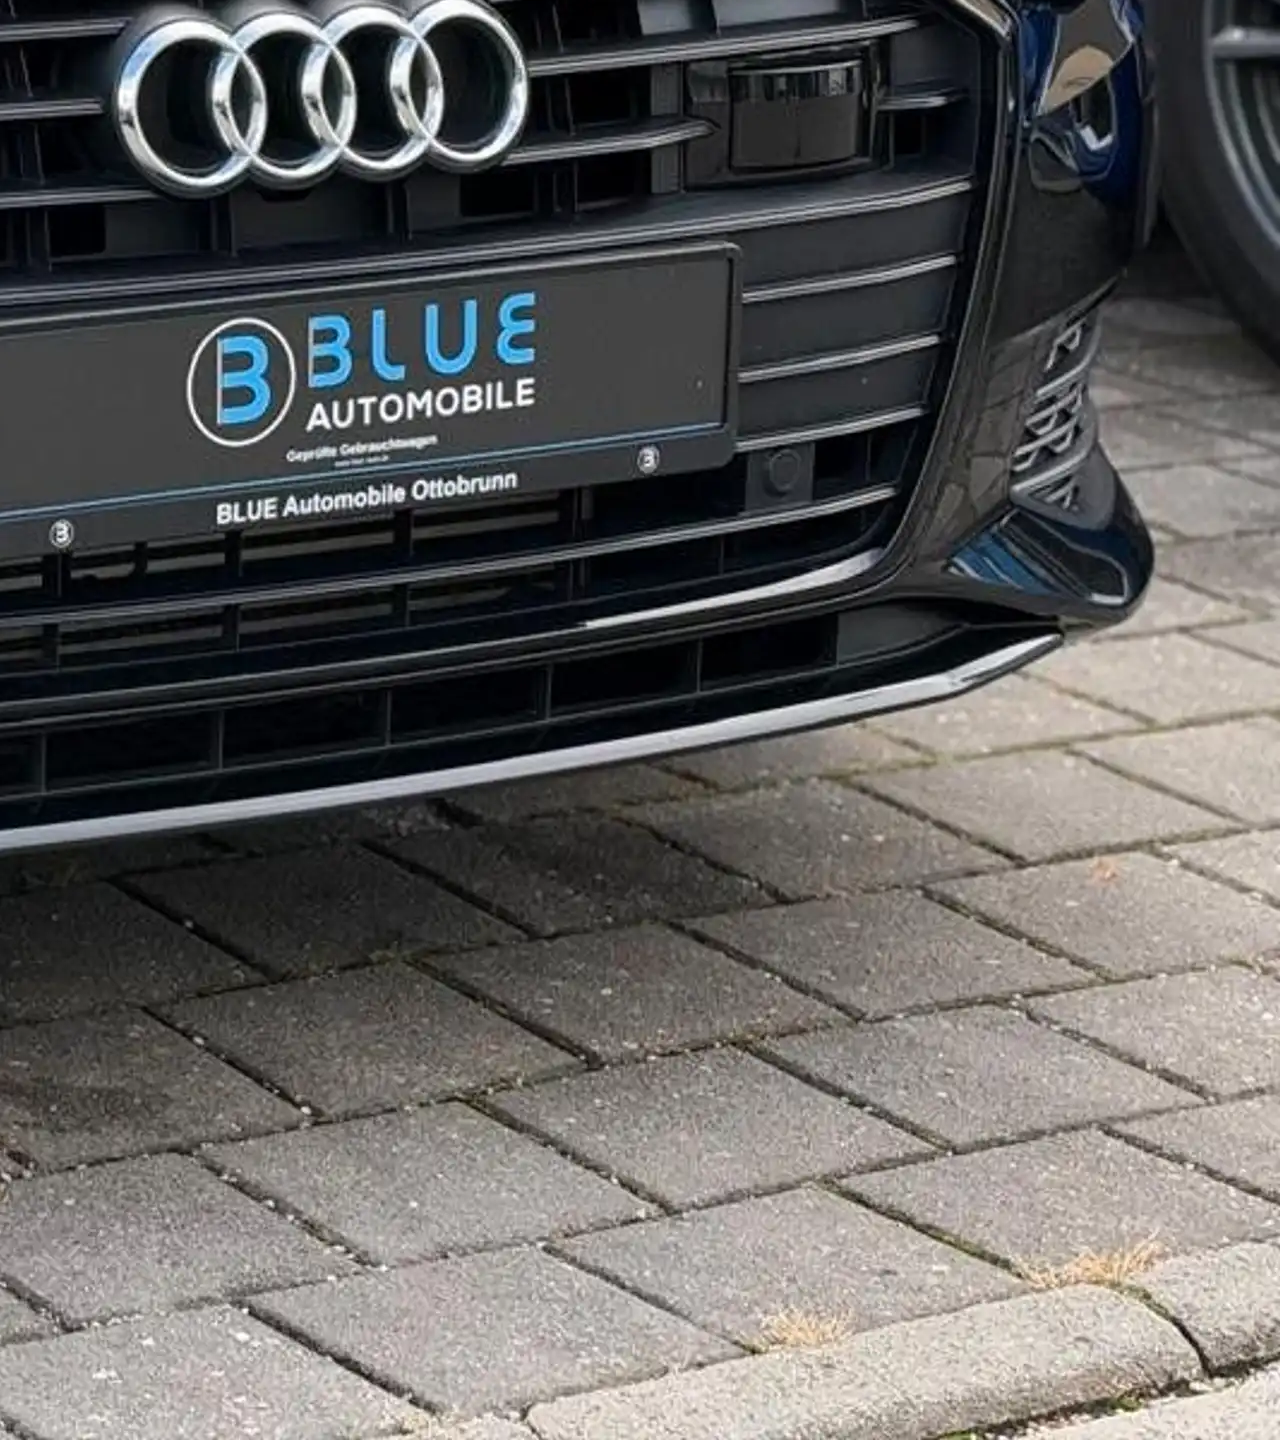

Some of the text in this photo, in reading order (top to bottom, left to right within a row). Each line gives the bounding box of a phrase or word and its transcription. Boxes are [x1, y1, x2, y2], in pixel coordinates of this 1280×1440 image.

[307, 291, 536, 389] BLUE
[305, 377, 537, 433] AUTOMOBILE
[216, 472, 518, 525] BLUE Automobile Ottobrunn
